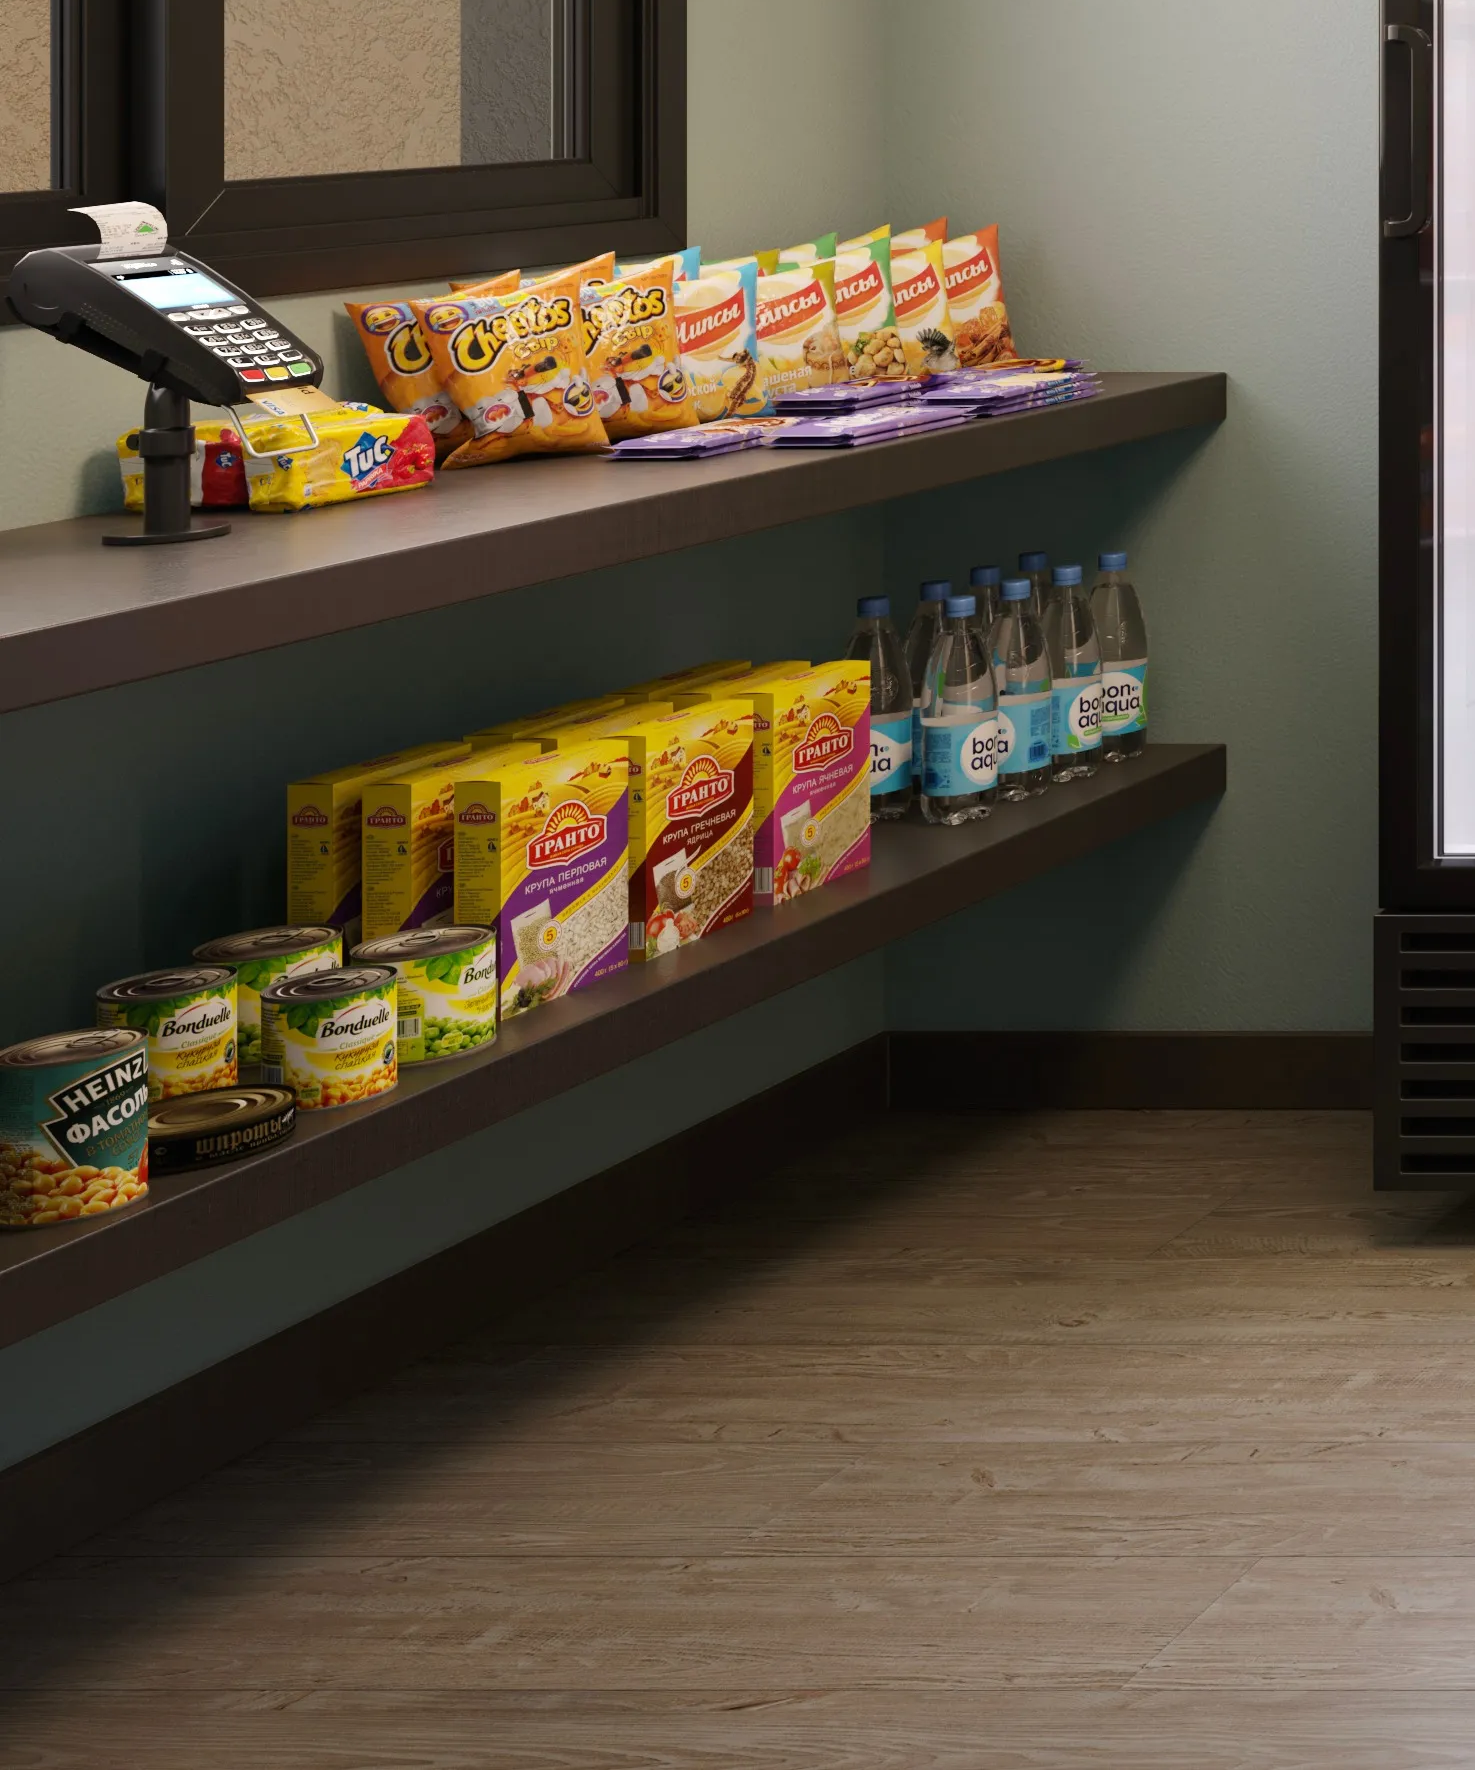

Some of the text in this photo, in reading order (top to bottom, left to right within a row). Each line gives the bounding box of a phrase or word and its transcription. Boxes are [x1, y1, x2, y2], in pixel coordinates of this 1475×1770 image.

[453, 296, 572, 375] Cheetos
[674, 303, 742, 344] Чипсы
[261, 399, 288, 417] VISA
[346, 436, 391, 479] TUC
[358, 468, 387, 491] PAPRIKA
[798, 735, 849, 764] ГРАНТО
[792, 764, 853, 794] КРУПА ЯЧНЕВАЯ
[535, 824, 600, 859] ГРАНТО
[663, 809, 736, 844] КРУПА ГРЕЧНЕВАЯ
[687, 830, 713, 846] ЯДРИЦА
[525, 857, 607, 895] КРУПА ПЕРЛОВАЯ
[549, 877, 584, 895] ячменная
[546, 929, 554, 940] 5
[321, 1007, 390, 1040] Bonduelle
[175, 1040, 223, 1062] Кукуруза
[181, 1032, 219, 1049] Classique
[64, 1058, 144, 1113] HEINZ
[66, 1085, 148, 1144] ФАСОЛЬ
[196, 1122, 283, 1155] шпроты
